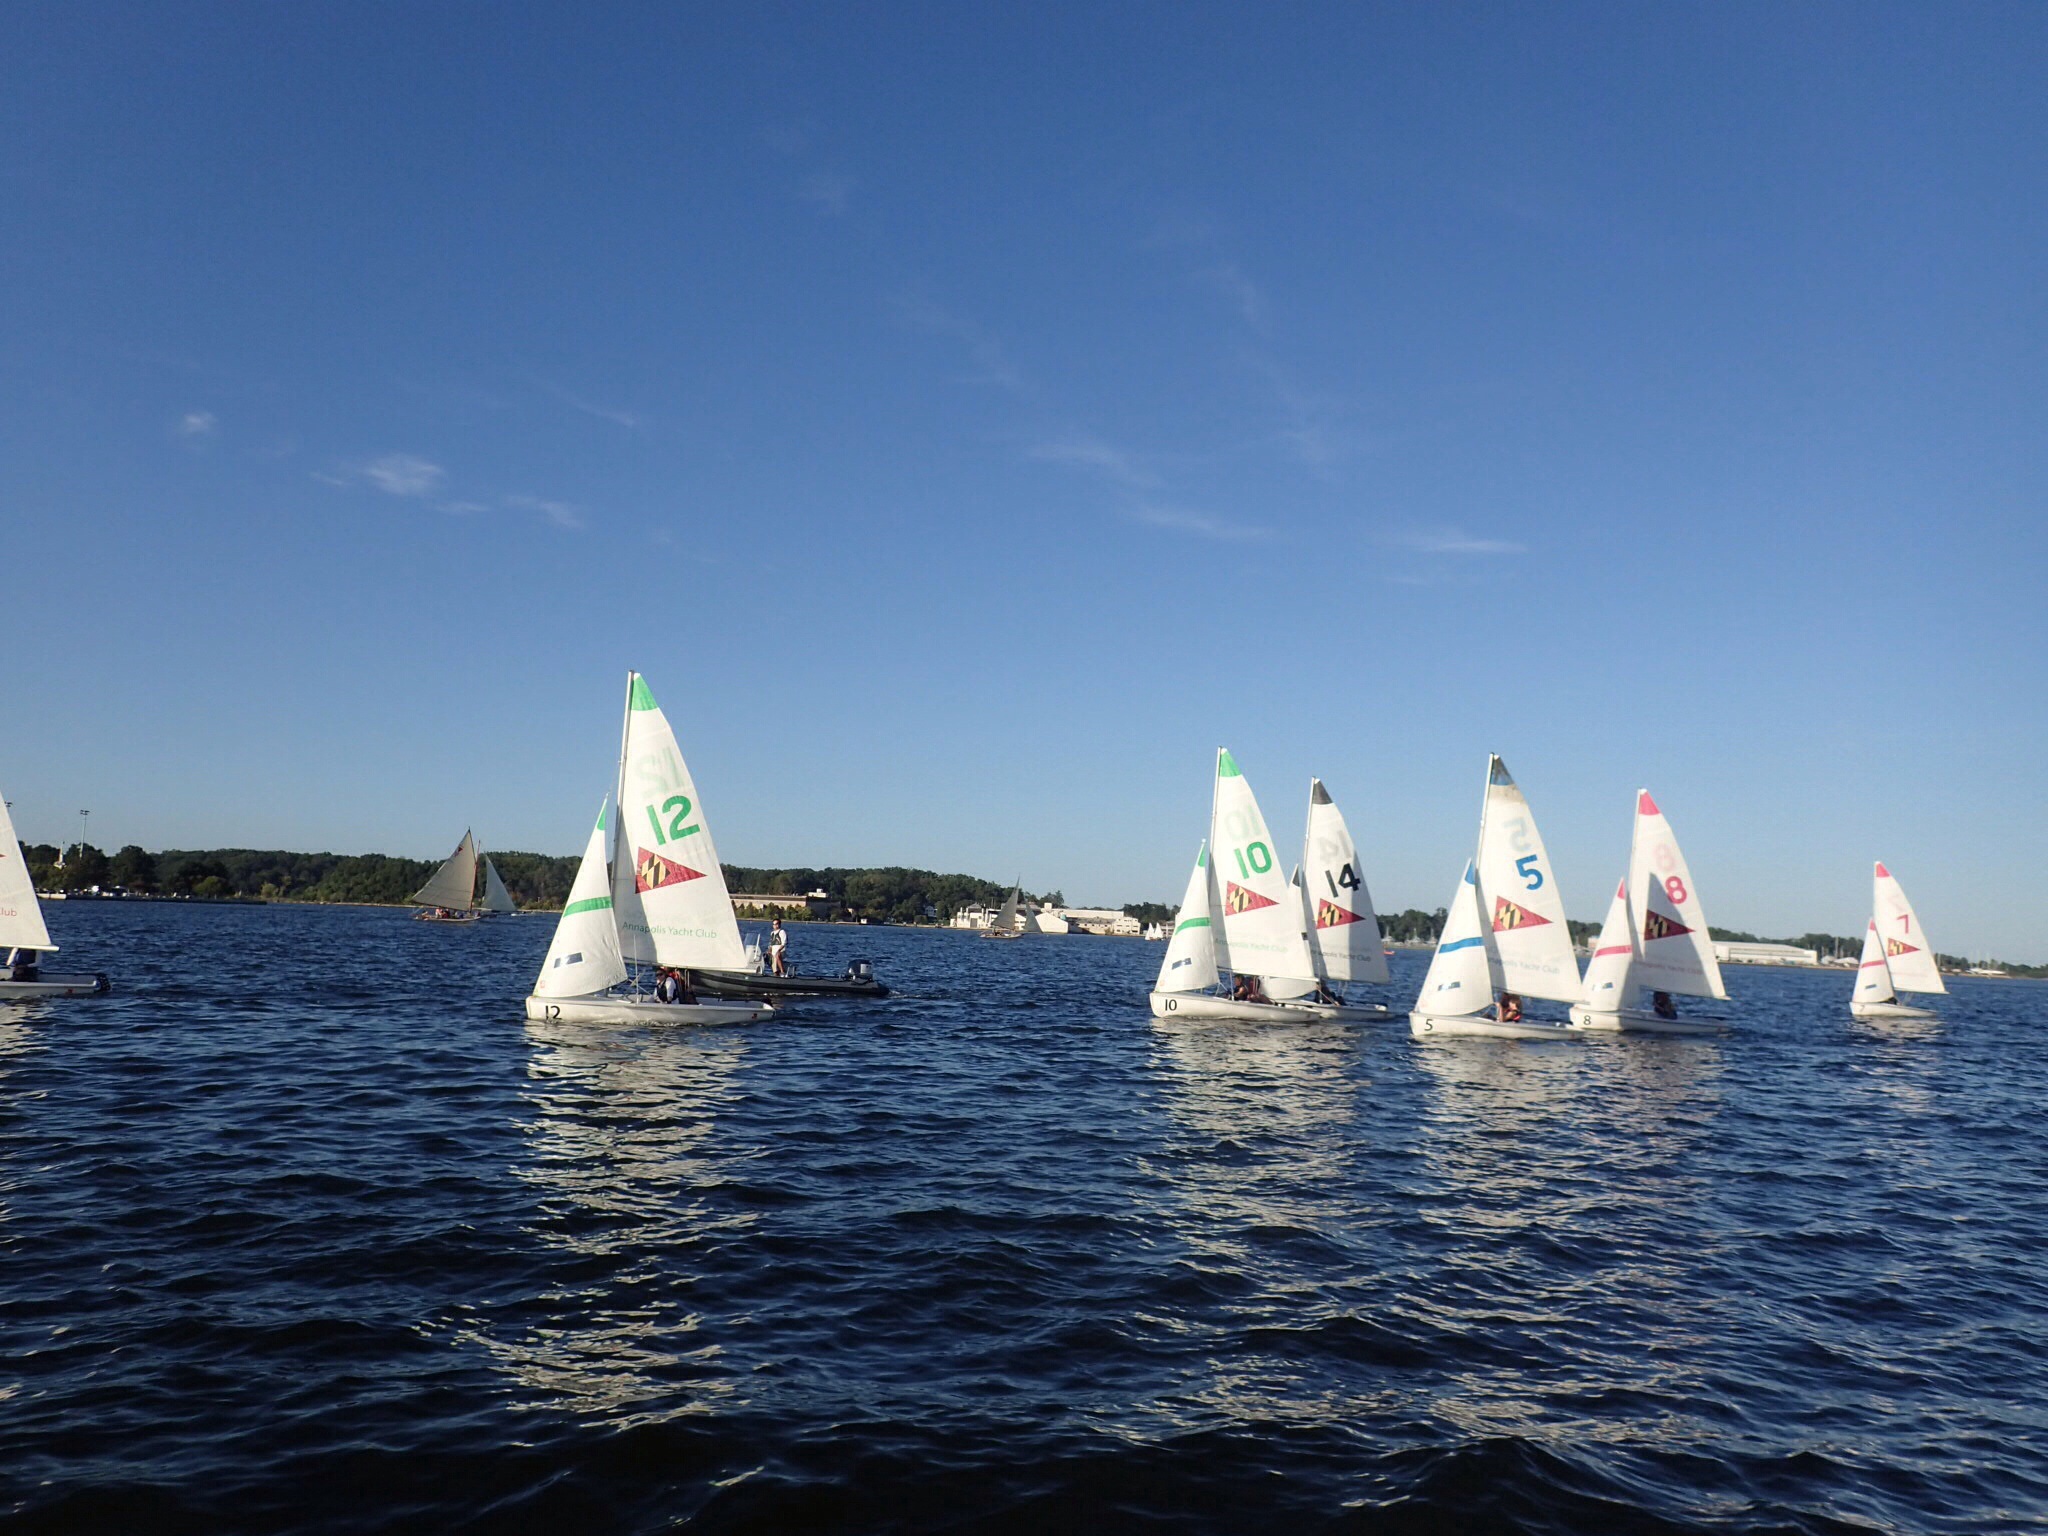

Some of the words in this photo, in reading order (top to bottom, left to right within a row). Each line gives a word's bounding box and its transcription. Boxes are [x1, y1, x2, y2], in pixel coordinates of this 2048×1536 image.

[646, 795, 701, 846] 12
[1233, 841, 1272, 880] 10
[1325, 863, 1361, 898] 14
[1515, 854, 1544, 890] 5
[1665, 875, 1687, 904] 8
[0, 907, 17, 916] lub
[622, 921, 666, 935] Annapolis
[667, 926, 693, 937] Yacht
[695, 928, 717, 939] Club
[1896, 914, 1909, 934] 7
[545, 1004, 562, 1020] 12
[1165, 999, 1177, 1011] 10
[1424, 1018, 1433, 1031] 5
[1583, 1015, 1591, 1025] 8
